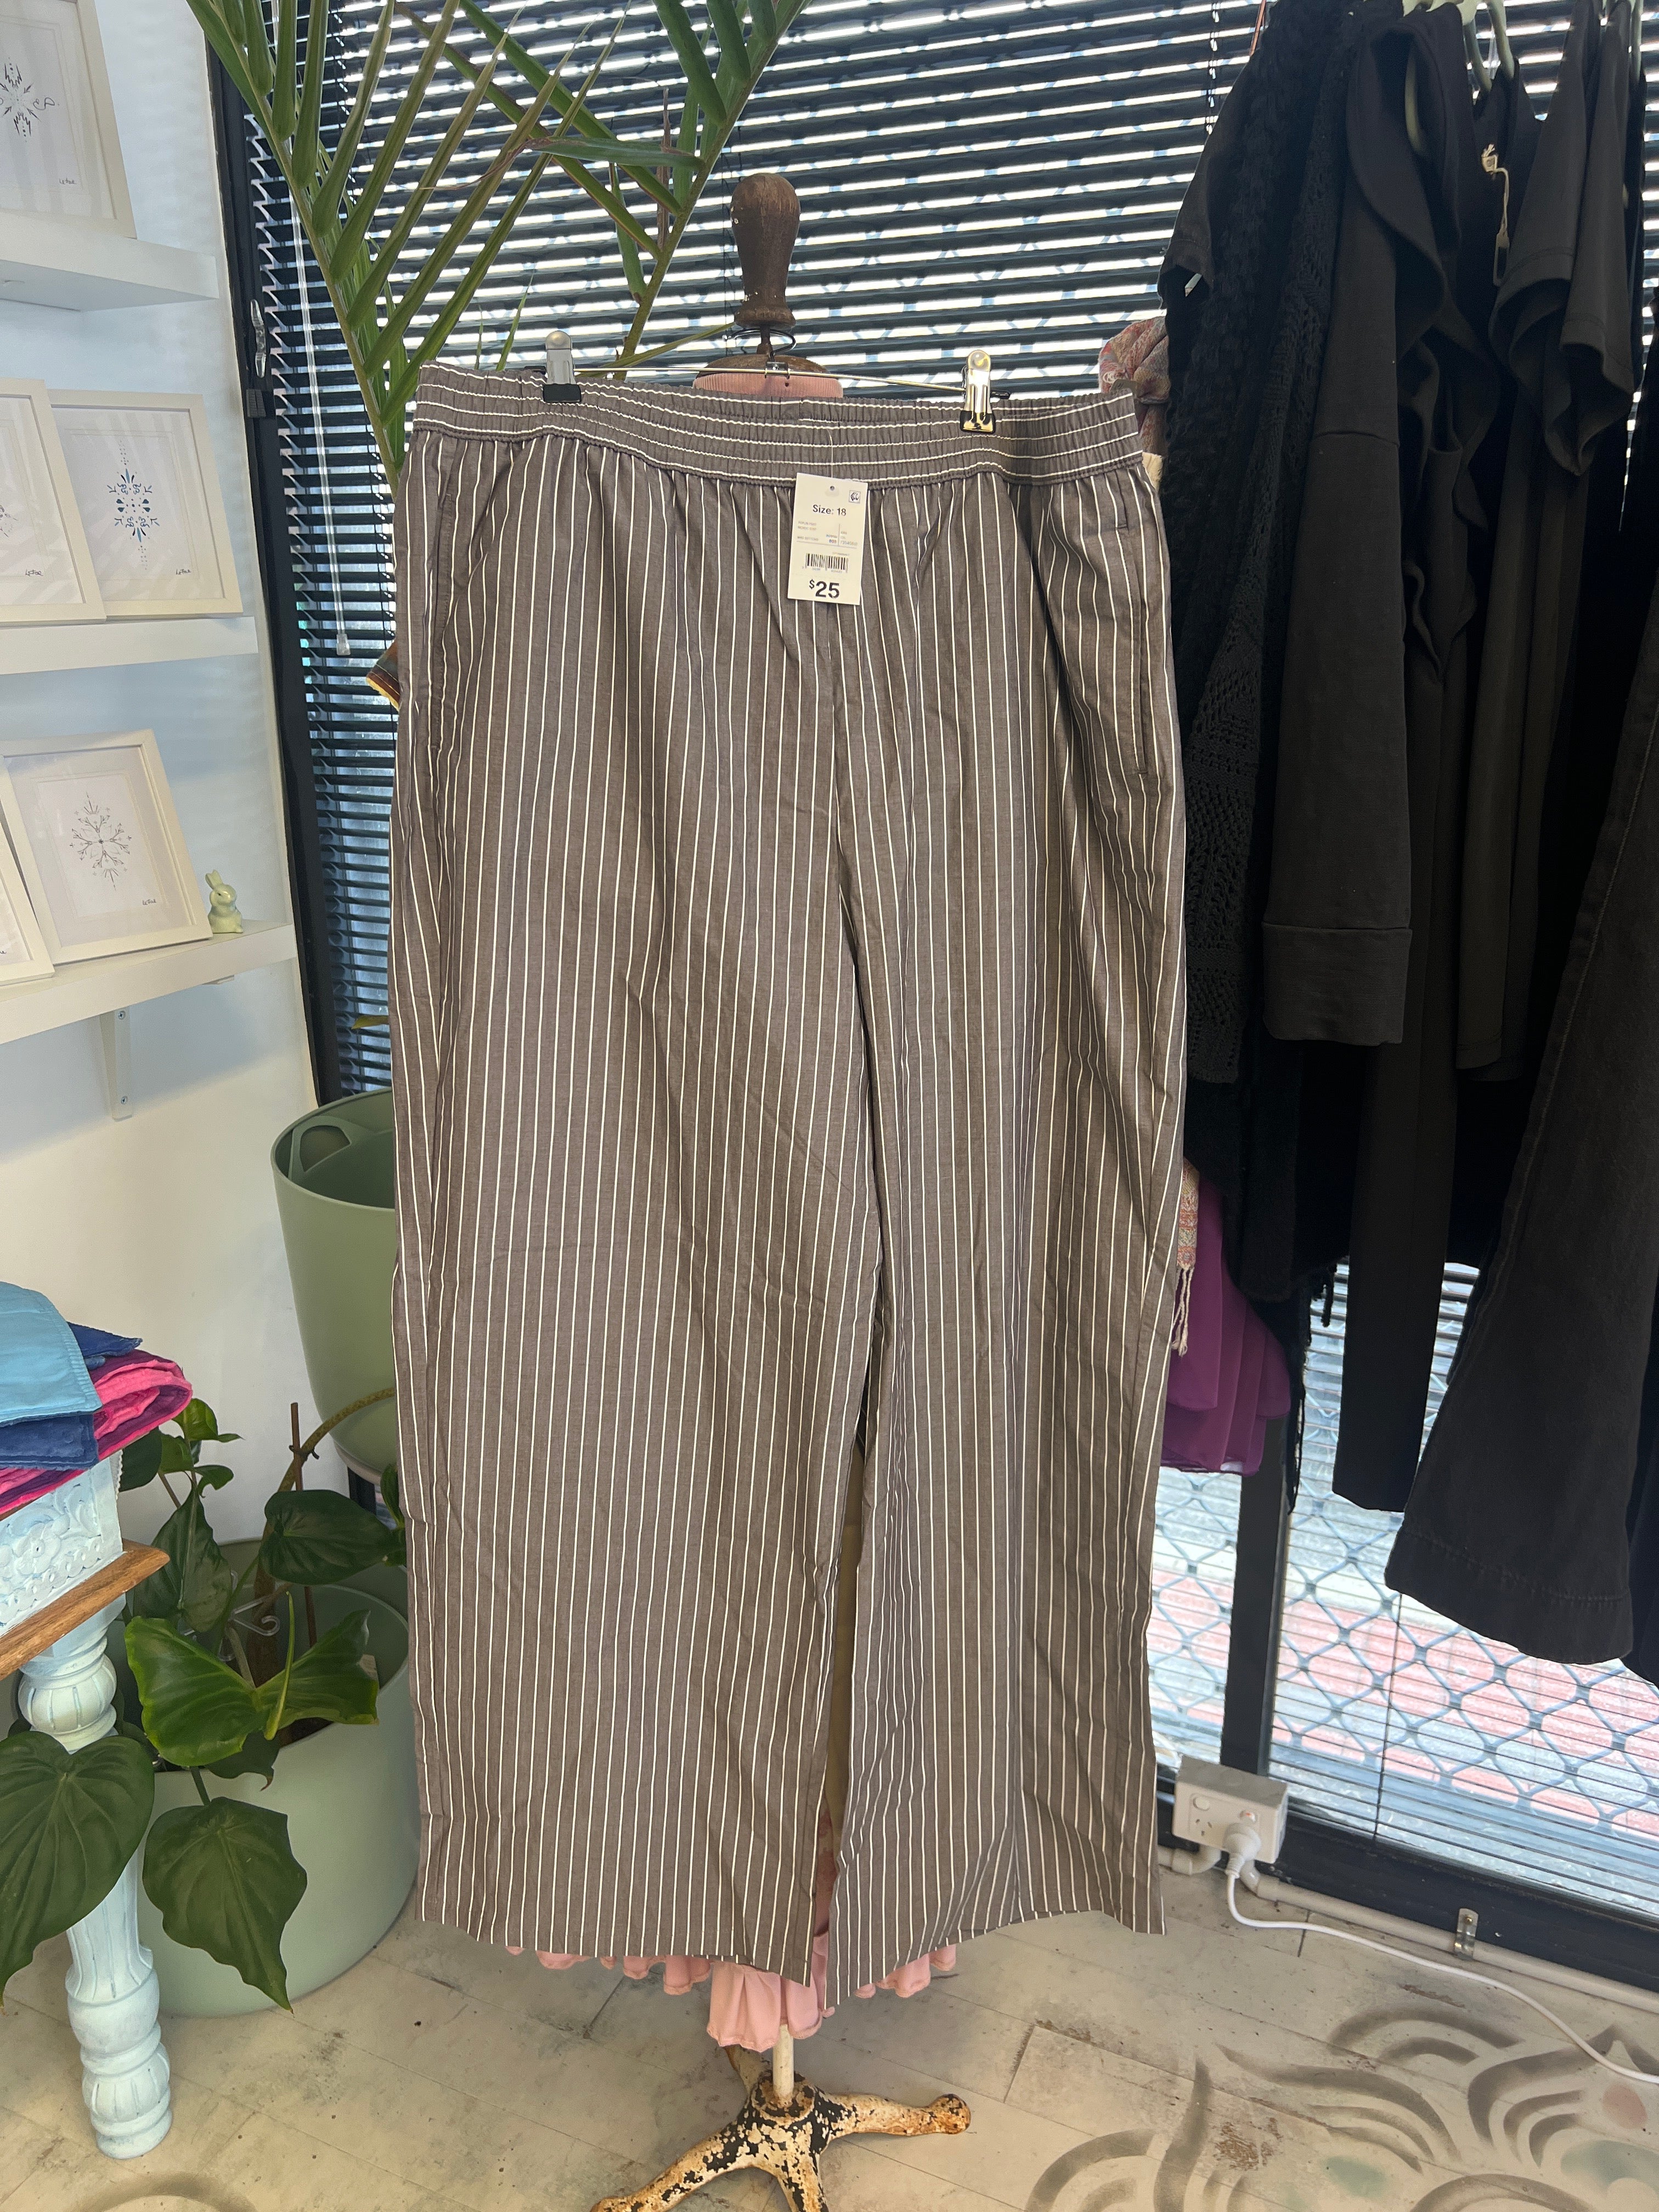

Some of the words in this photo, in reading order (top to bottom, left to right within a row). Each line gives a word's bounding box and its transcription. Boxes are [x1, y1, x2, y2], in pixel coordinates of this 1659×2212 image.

[812, 504, 834, 515] Size:
[837, 507, 847, 516] 18
[809, 579, 840, 599] $25
